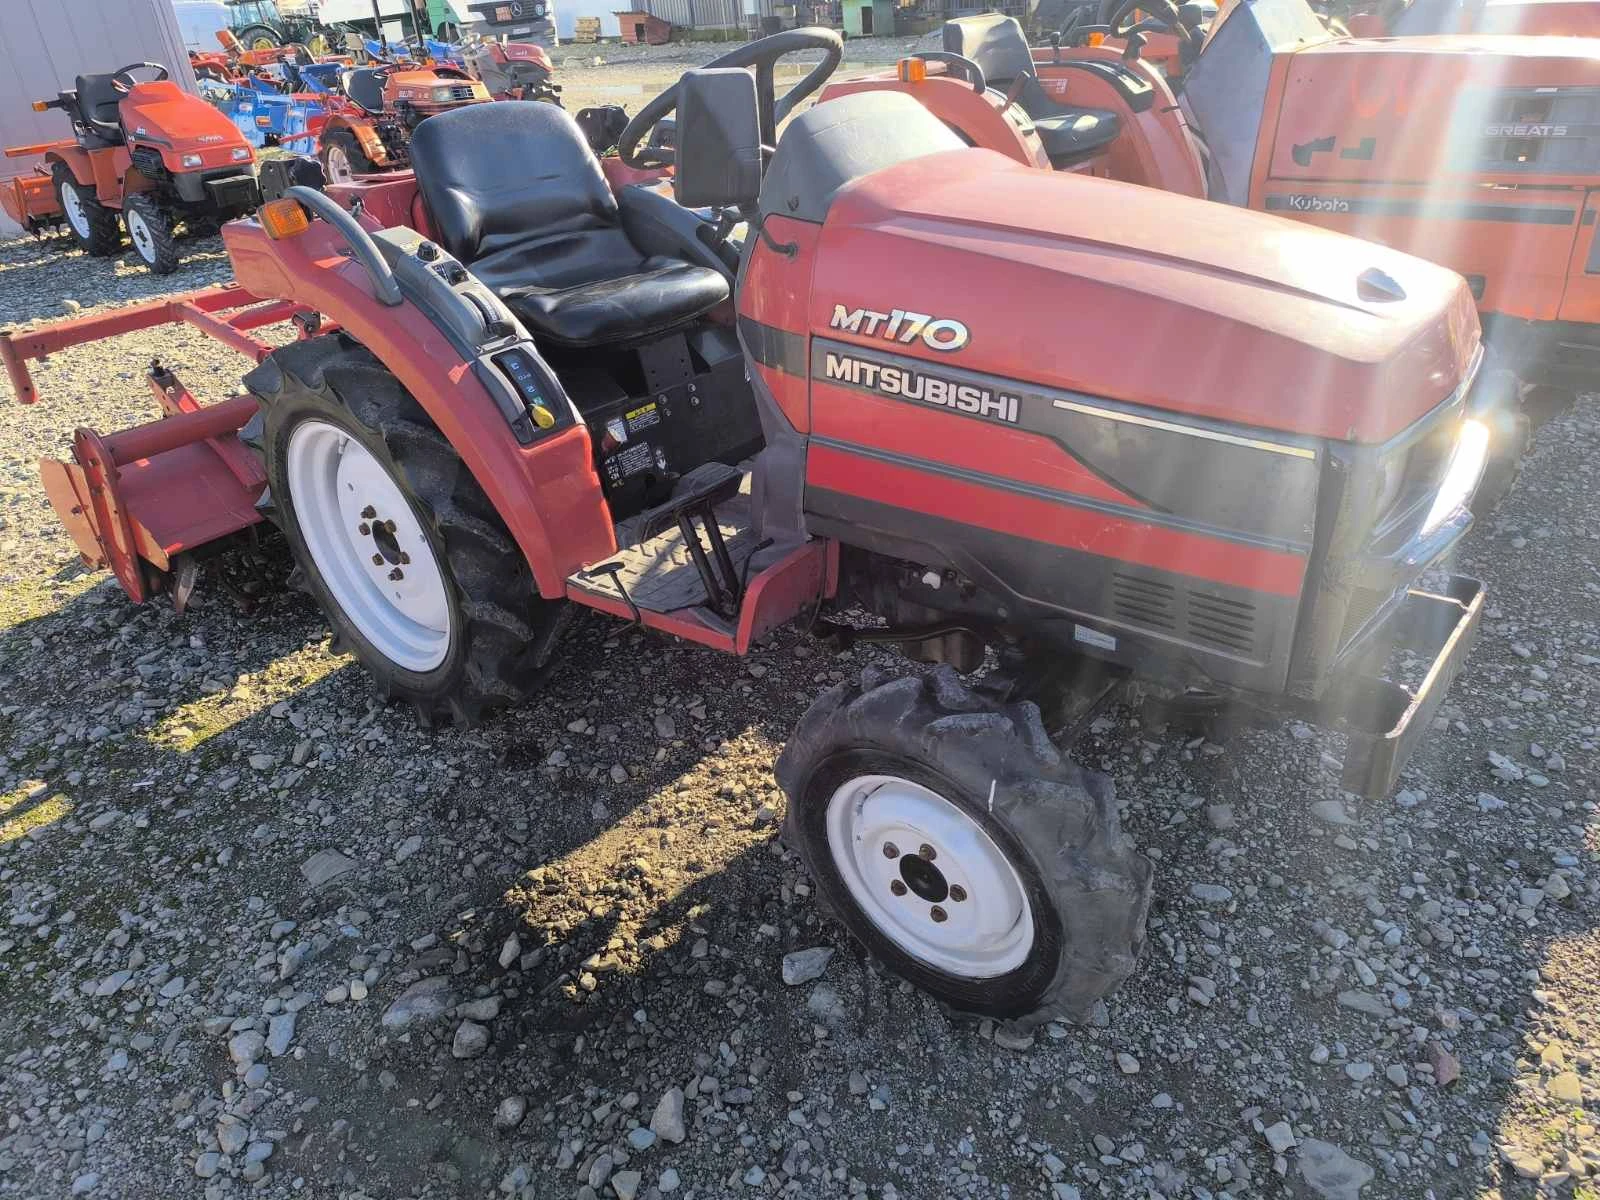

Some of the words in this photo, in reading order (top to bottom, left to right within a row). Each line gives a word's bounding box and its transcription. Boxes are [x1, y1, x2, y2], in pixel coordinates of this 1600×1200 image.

[1290, 195, 1349, 211] Kubota
[830, 304, 969, 350] MT170
[826, 354, 1018, 423] MITSUBISHI
